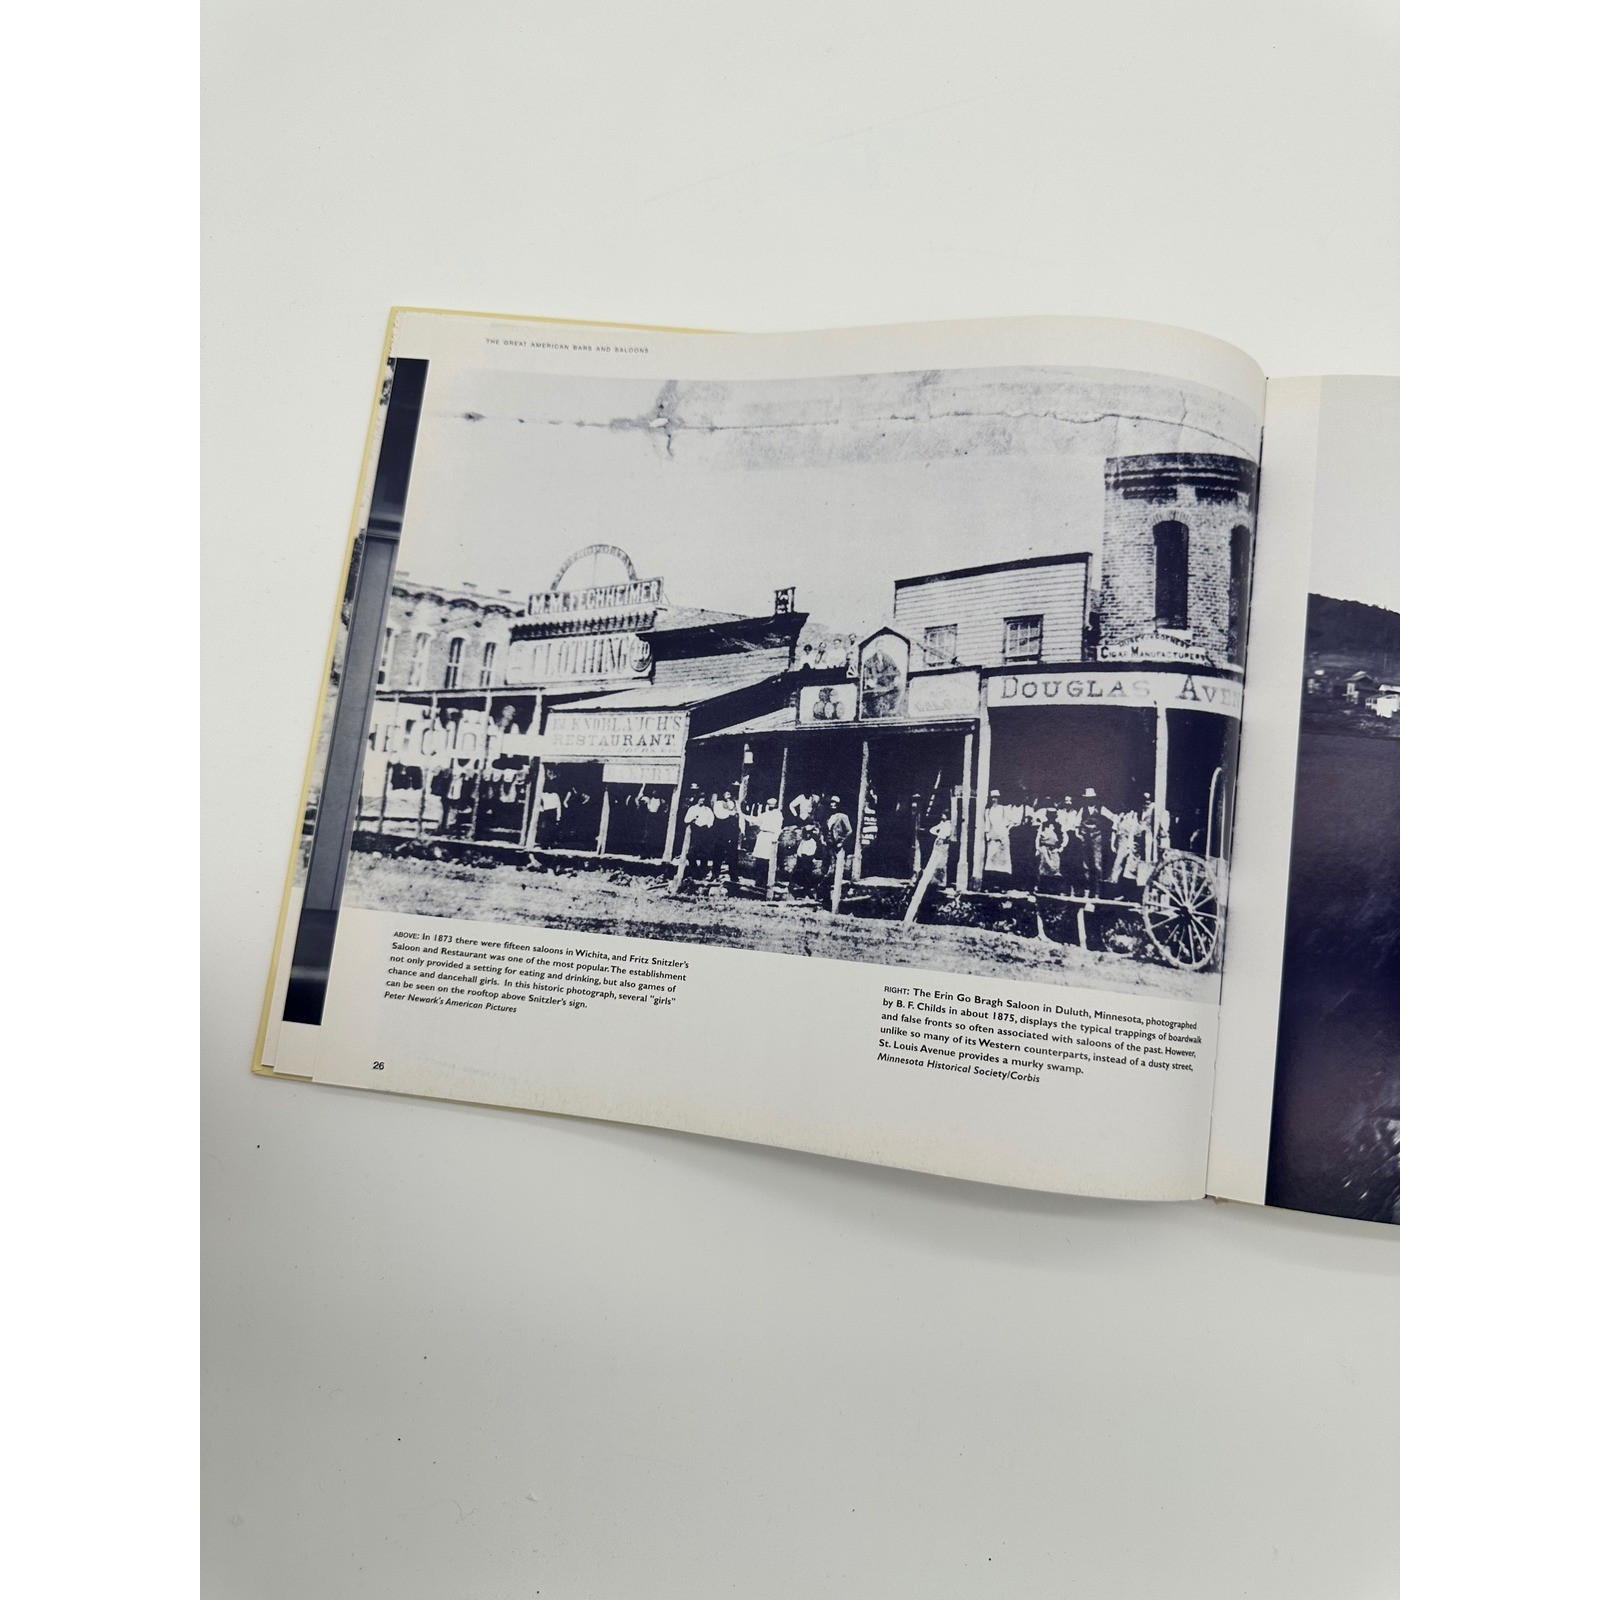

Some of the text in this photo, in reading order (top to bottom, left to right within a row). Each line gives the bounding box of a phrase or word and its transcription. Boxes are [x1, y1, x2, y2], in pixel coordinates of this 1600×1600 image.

[503, 339, 527, 347] GREAT
[530, 342, 569, 351] AMERICAN
[573, 344, 593, 352] BARS
[533, 636, 629, 677] CLOTHING
[392, 941, 687, 982] Saloon and Restaurant was one of the most popular. The establishment
[393, 931, 420, 940] ABOVE:
[422, 932, 431, 941] In
[434, 934, 453, 943] 1873
[455, 936, 479, 946] there
[480, 940, 502, 949] were
[503, 941, 531, 952] fifteen
[532, 945, 564, 955] saloons
[565, 947, 574, 956] in
[575, 948, 611, 962] Wichita,
[611, 954, 628, 962] and
[629, 954, 649, 965] Fritz
[387, 967, 418, 977] chance
[419, 971, 436, 979] and
[437, 972, 478, 984] dancehall
[479, 976, 500, 987] girls.
[504, 979, 513, 987] In
[515, 980, 531, 989] this
[532, 982, 565, 993] historic
[566, 986, 617, 1000] photograph,
[618, 993, 648, 1003] several
[406, 957, 425, 967] only
[426, 960, 464, 970] provided
[473, 964, 503, 976] setting
[504, 966, 518, 975] for
[519, 969, 546, 981] eating
[547, 972, 564, 980] and
[565, 973, 602, 987] drinking,
[602, 977, 618, 987] but
[619, 979, 636, 989] also
[637, 983, 665, 992] games
[667, 985, 677, 993] of
[383, 991, 406, 1000] Peter
[444, 998, 484, 1009] American
[485, 1002, 517, 1013] Pictures
[385, 980, 401, 988] can
[403, 980, 414, 989] be
[416, 984, 436, 992] seen
[451, 986, 465, 995] the
[467, 989, 500, 1000] rooftop
[501, 992, 526, 1002] above
[569, 999, 588, 1010] sign.
[884, 985, 1198, 1031] RIGHT: The Erin Go Bragh Saloon in Duluth, Minnesota, photographed
[881, 1013, 1196, 1059] and false fronts so often associated with saloons of the past. However,
[882, 997, 1202, 1044] by B. F. Childs in about 1875, displays the typical trappings of boardwalk
[373, 1061, 385, 1070] 26
[878, 1038, 1084, 1076] St. Louis Avenue provides a murky swamp.
[880, 1026, 908, 1037] unlike
[910, 1031, 921, 1039] so
[923, 1033, 950, 1044] many
[952, 1035, 964, 1044] of
[964, 1036, 977, 1046] its
[978, 1037, 1021, 1052] Western
[1023, 1046, 1091, 1062] counterparts,
[1092, 1052, 1127, 1065] instead
[1129, 1057, 1140, 1066] of
[1148, 1059, 1170, 1071] dusty
[1171, 1063, 1194, 1072] street,
[877, 1052, 1040, 1083] Minnesota Historical Society/Corbis
